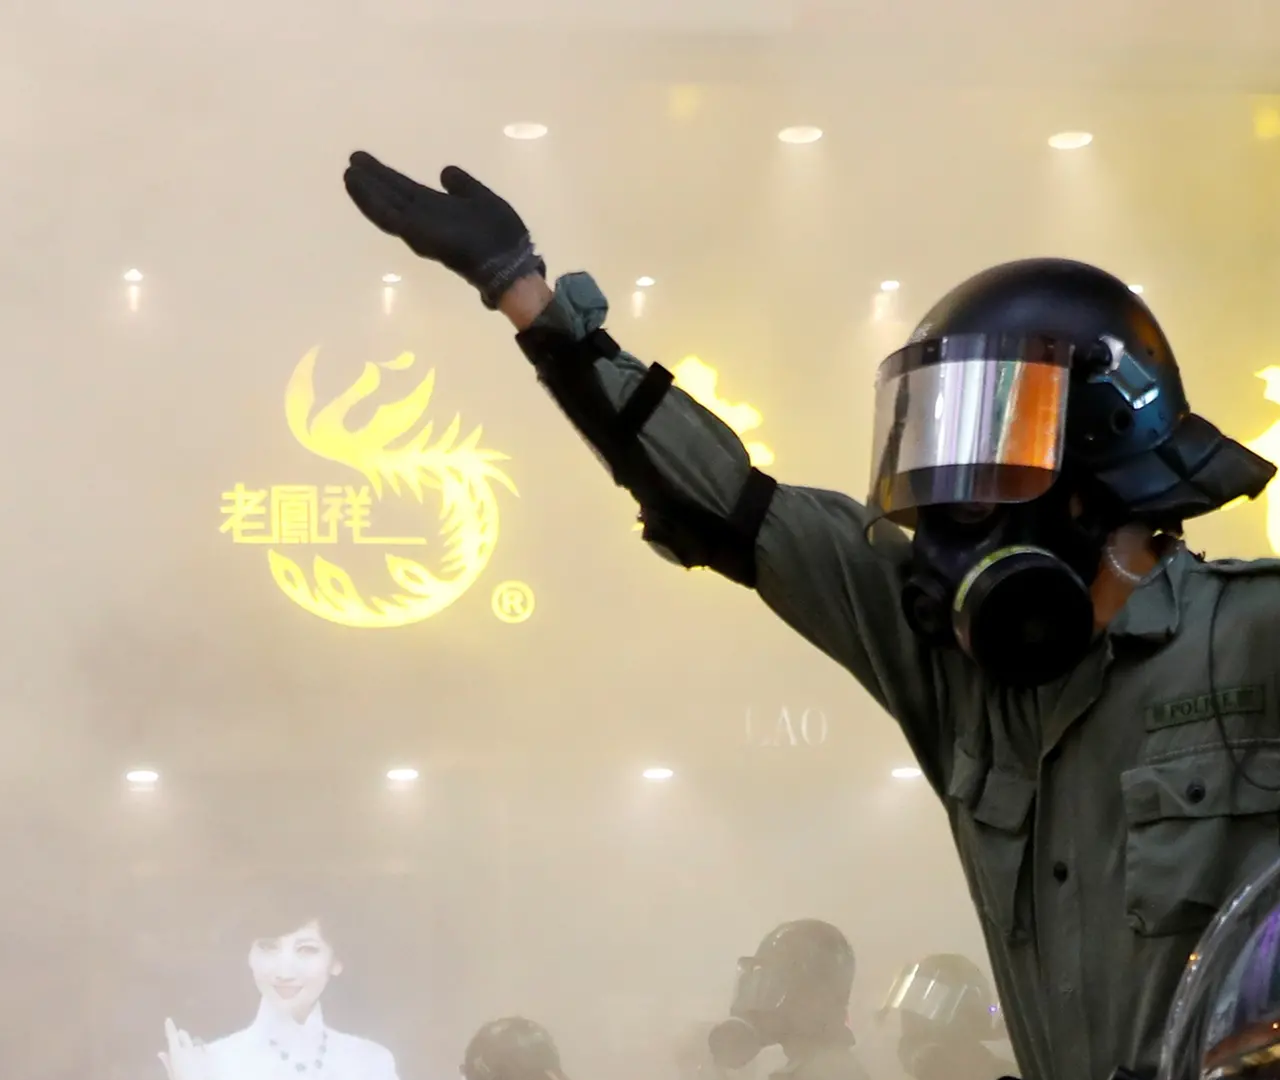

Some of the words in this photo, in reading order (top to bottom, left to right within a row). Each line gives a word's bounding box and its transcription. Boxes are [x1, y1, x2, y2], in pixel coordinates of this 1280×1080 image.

[218, 481, 375, 545] 老鳳祥
[744, 704, 829, 748] LAO
[1170, 692, 1230, 718] POLIE
